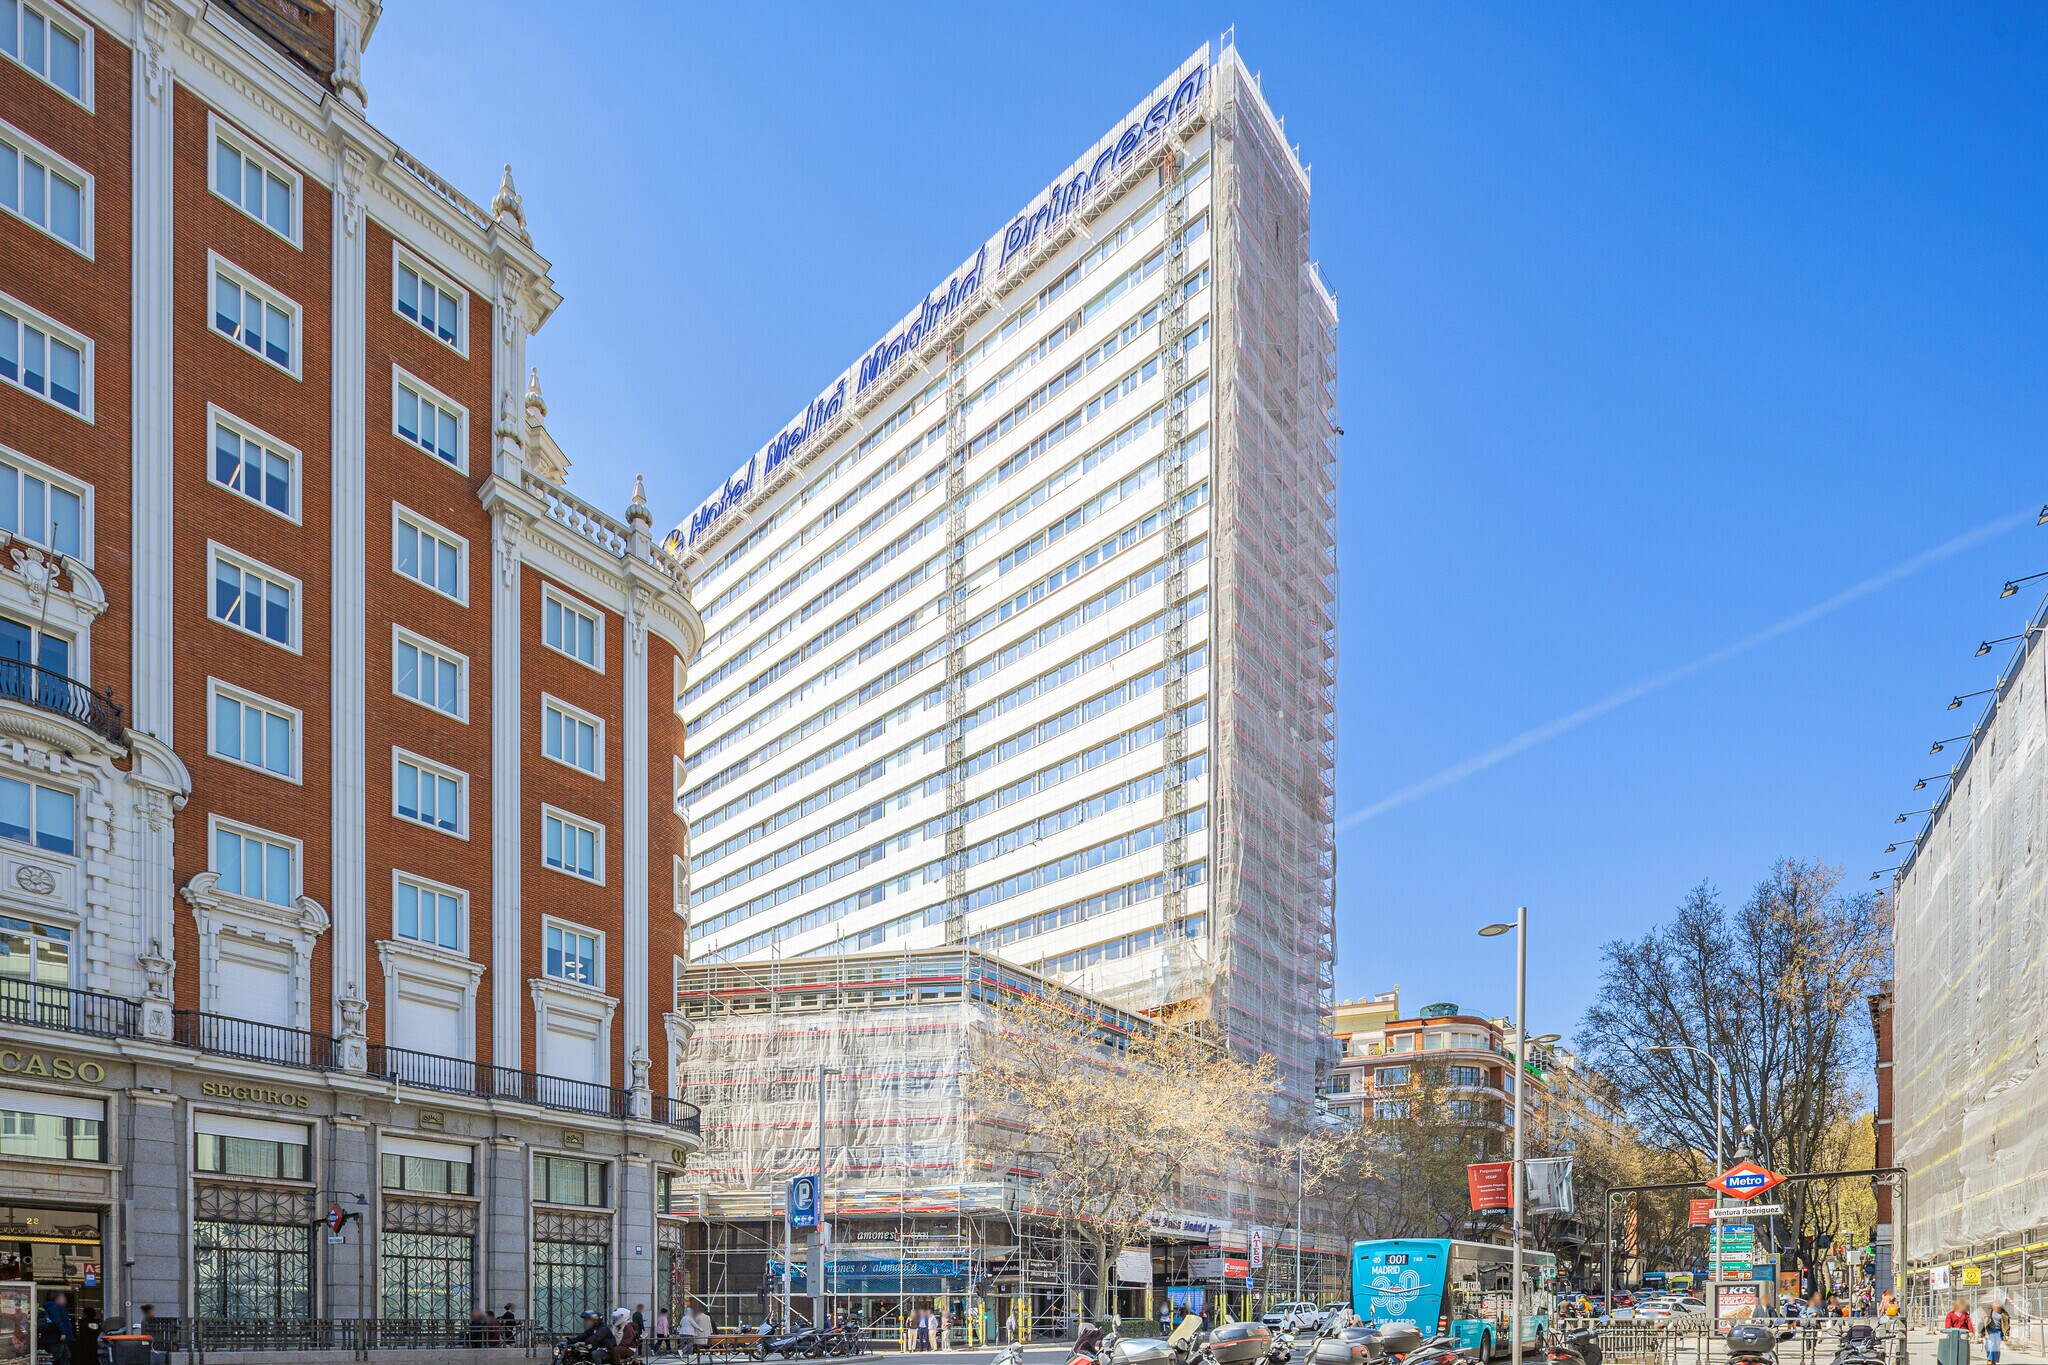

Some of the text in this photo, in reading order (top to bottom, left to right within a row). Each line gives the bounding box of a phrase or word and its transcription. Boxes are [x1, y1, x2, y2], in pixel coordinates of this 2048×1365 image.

[689, 63, 1204, 547] Hotel Meliá Madrid Princesa
[202, 1081, 310, 1109] SEGUROS
[1729, 1177, 1762, 1186] Metro
[1714, 1208, 1740, 1216] Ventura
[1389, 1255, 1406, 1264] 001
[1371, 1266, 1400, 1275] MADRID
[1729, 1286, 1756, 1294] KFC
